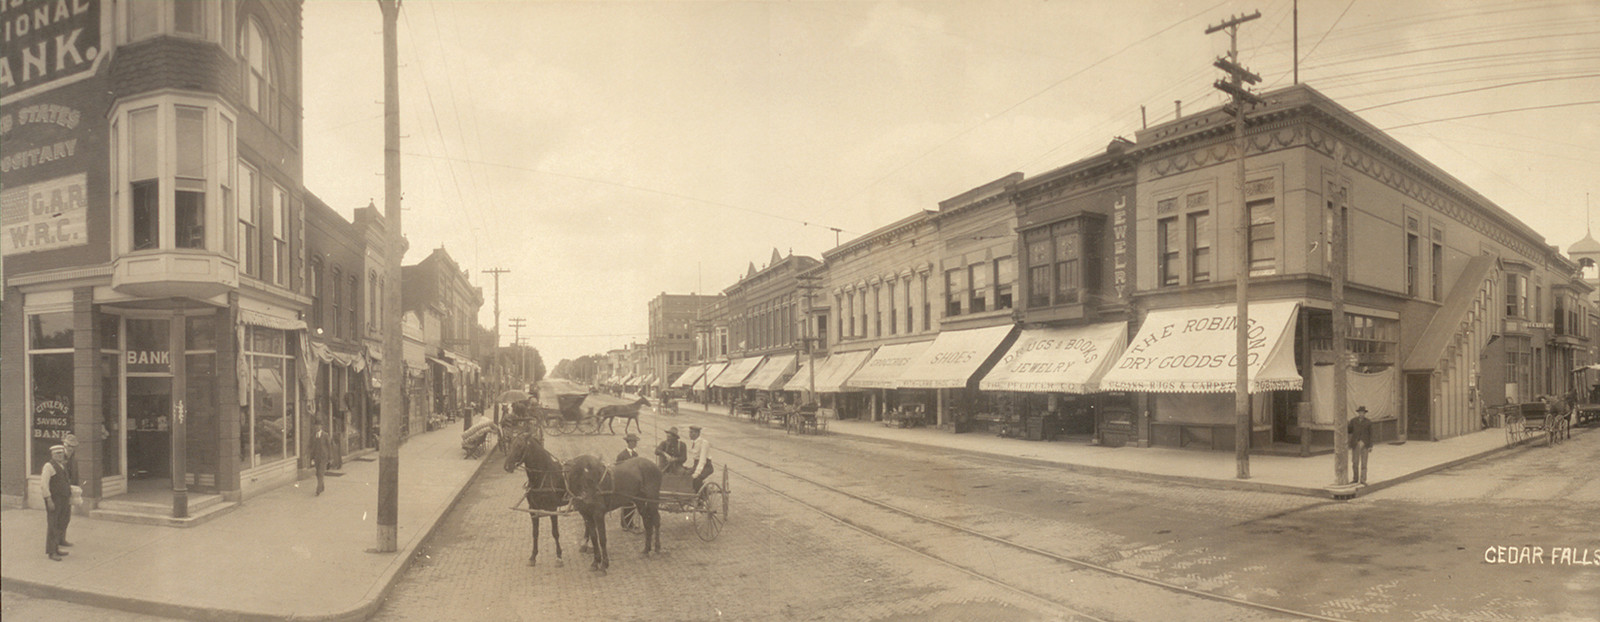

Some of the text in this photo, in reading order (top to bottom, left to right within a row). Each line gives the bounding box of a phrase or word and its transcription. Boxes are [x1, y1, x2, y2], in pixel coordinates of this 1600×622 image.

[18, 104, 81, 129] STATES
[9, 218, 78, 249] W.R.C.
[1113, 195, 1127, 298] JEWELRY
[1131, 324, 1174, 354] THE
[126, 351, 170, 364] BANK
[930, 350, 977, 365] SHOES
[1004, 339, 1055, 364] DRUGS
[1064, 338, 1098, 364] BOOKS
[1011, 361, 1075, 373] JEWELRY
[1119, 353, 1260, 370] DRY GOODS CO.
[1150, 381, 1175, 389] RUGS
[36, 400, 69, 414] CITIZENS
[36, 418, 67, 427] SAVINGS
[34, 429, 72, 439] BANK
